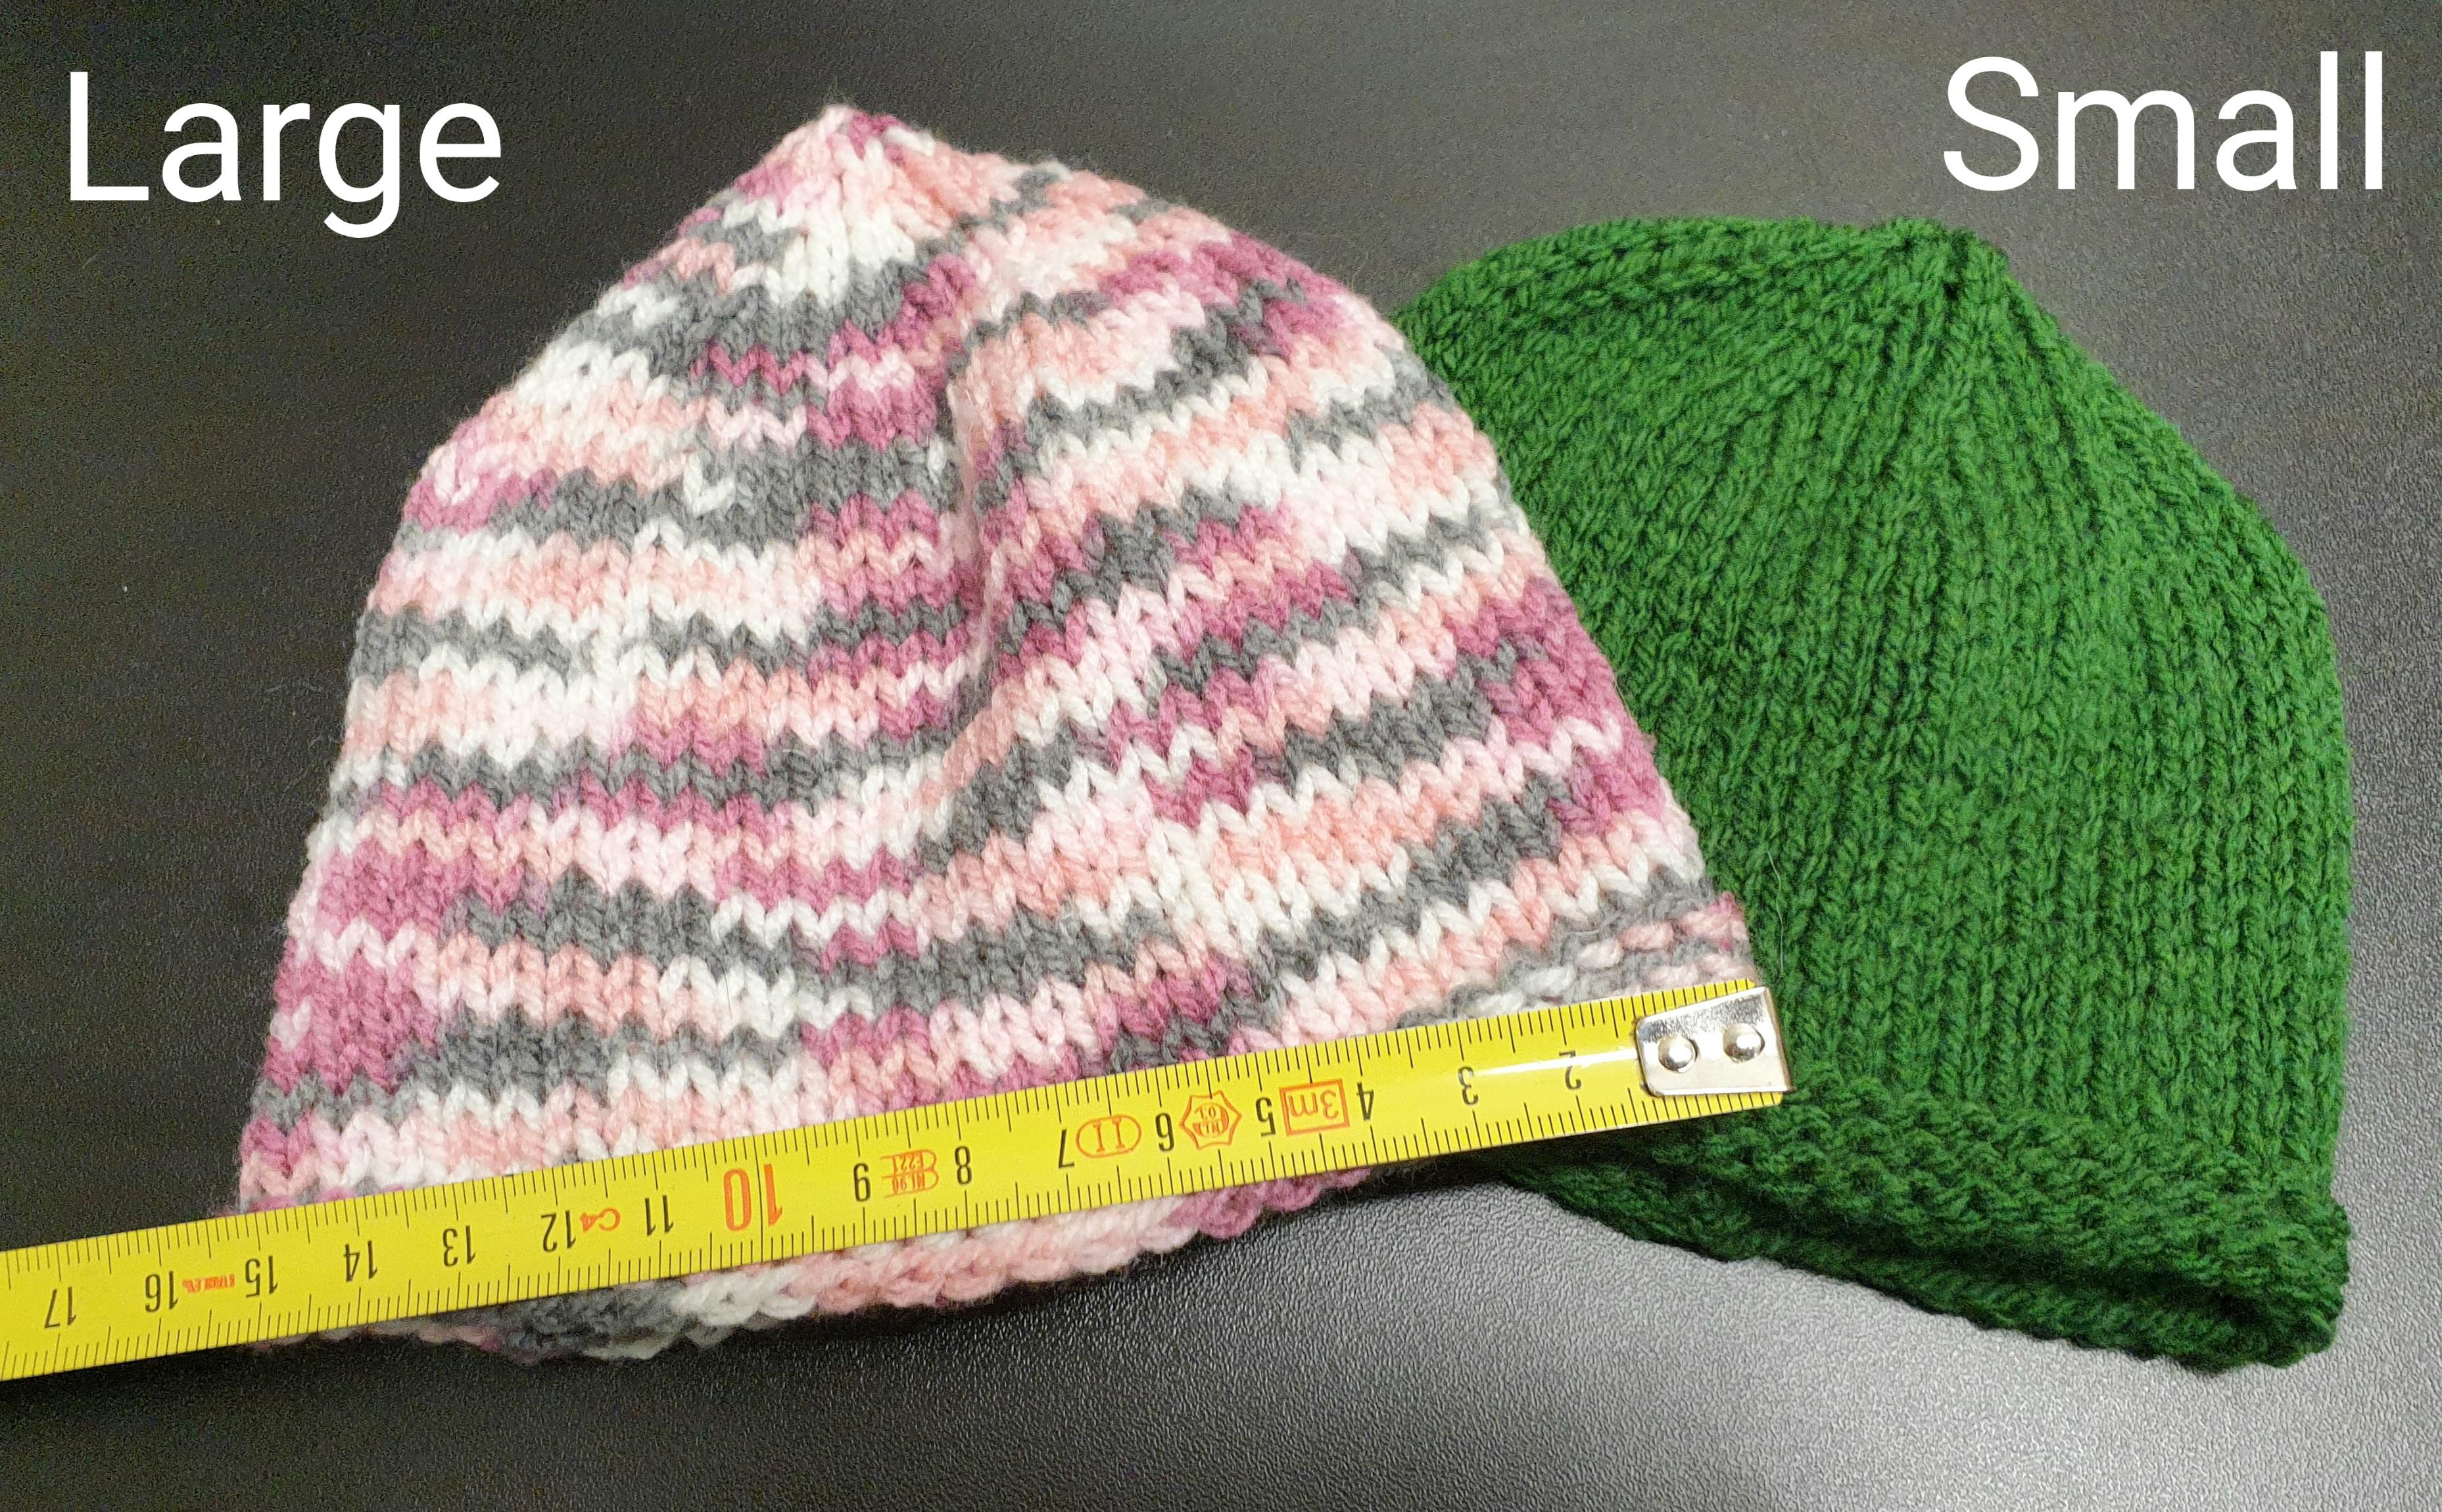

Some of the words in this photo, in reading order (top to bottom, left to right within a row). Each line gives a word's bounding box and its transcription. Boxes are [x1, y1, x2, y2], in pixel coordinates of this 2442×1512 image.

[1458, 1066, 1479, 1106] 3
[1558, 1050, 1582, 1091] 2
[1255, 1097, 1277, 1137] 5
[1287, 1088, 1339, 1120] 3m
[1356, 1081, 1375, 1122] 4
[1057, 1128, 1076, 1169] 7
[1155, 1112, 1175, 1152] 6
[852, 1162, 871, 1202] 9
[953, 1145, 972, 1185] 8
[644, 1194, 675, 1237] 11
[722, 1162, 784, 1233] 10
[442, 1225, 477, 1267] 13
[540, 1210, 577, 1253] 12
[245, 1255, 279, 1298] 15
[343, 1240, 378, 1283] 14
[43, 1286, 77, 1329] 17
[144, 1270, 179, 1313] 16
